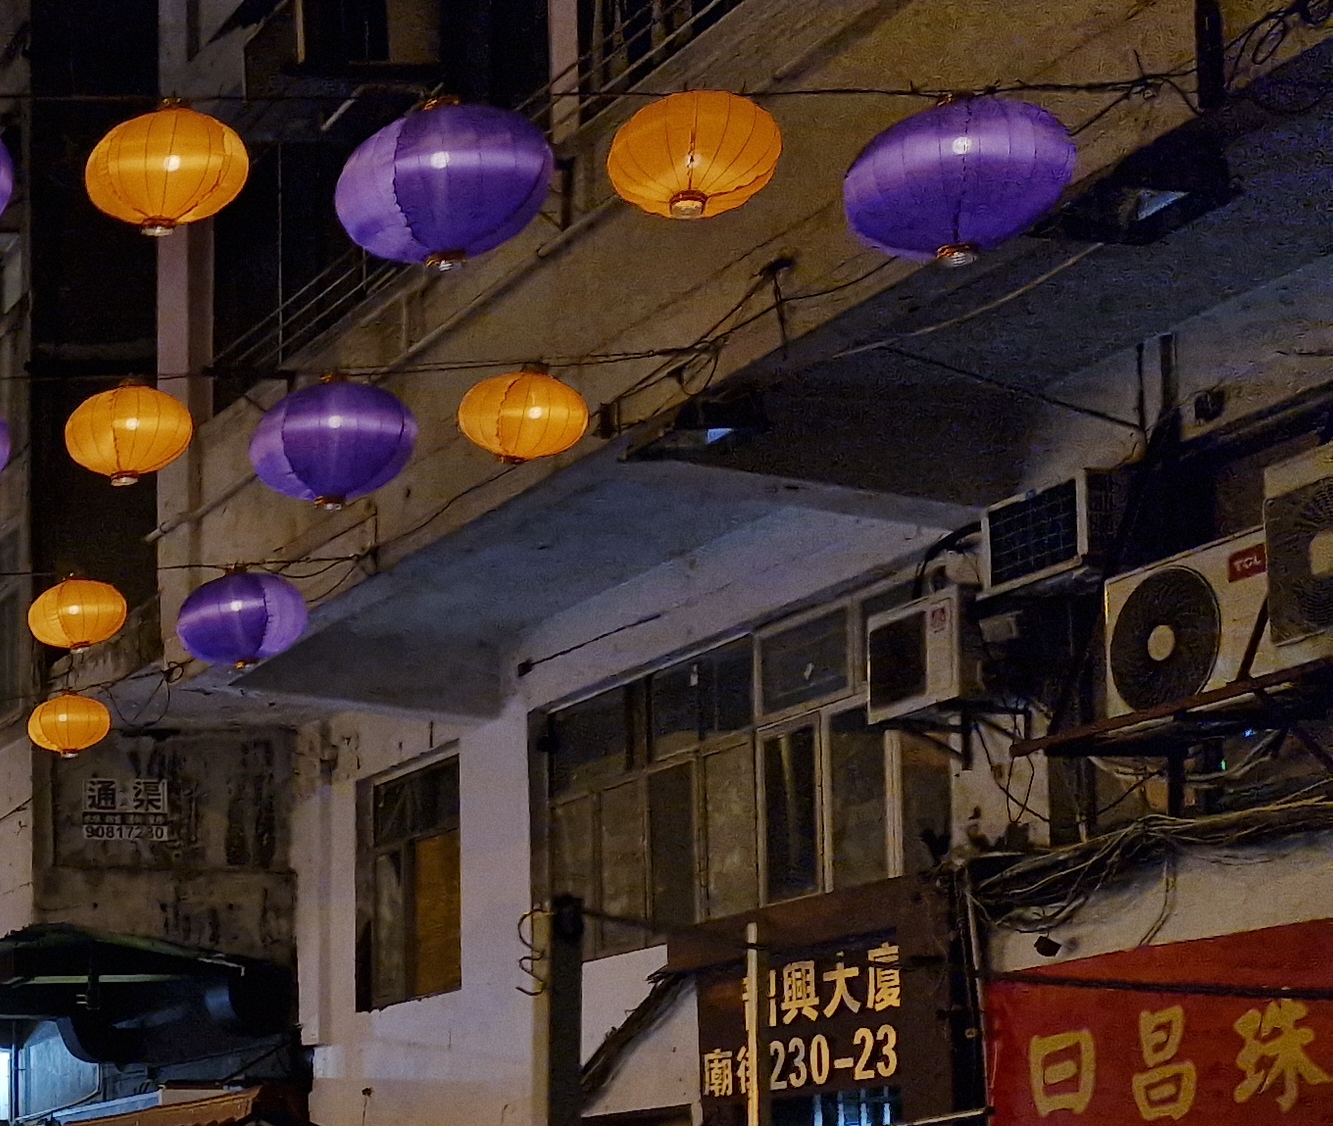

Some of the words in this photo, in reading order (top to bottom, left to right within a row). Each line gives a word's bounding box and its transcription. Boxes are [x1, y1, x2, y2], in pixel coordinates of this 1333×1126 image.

[88, 780, 161, 811] 通渠
[769, 1025, 898, 1091] 230-23
[1029, 999, 1333, 1121] 日昌珠
